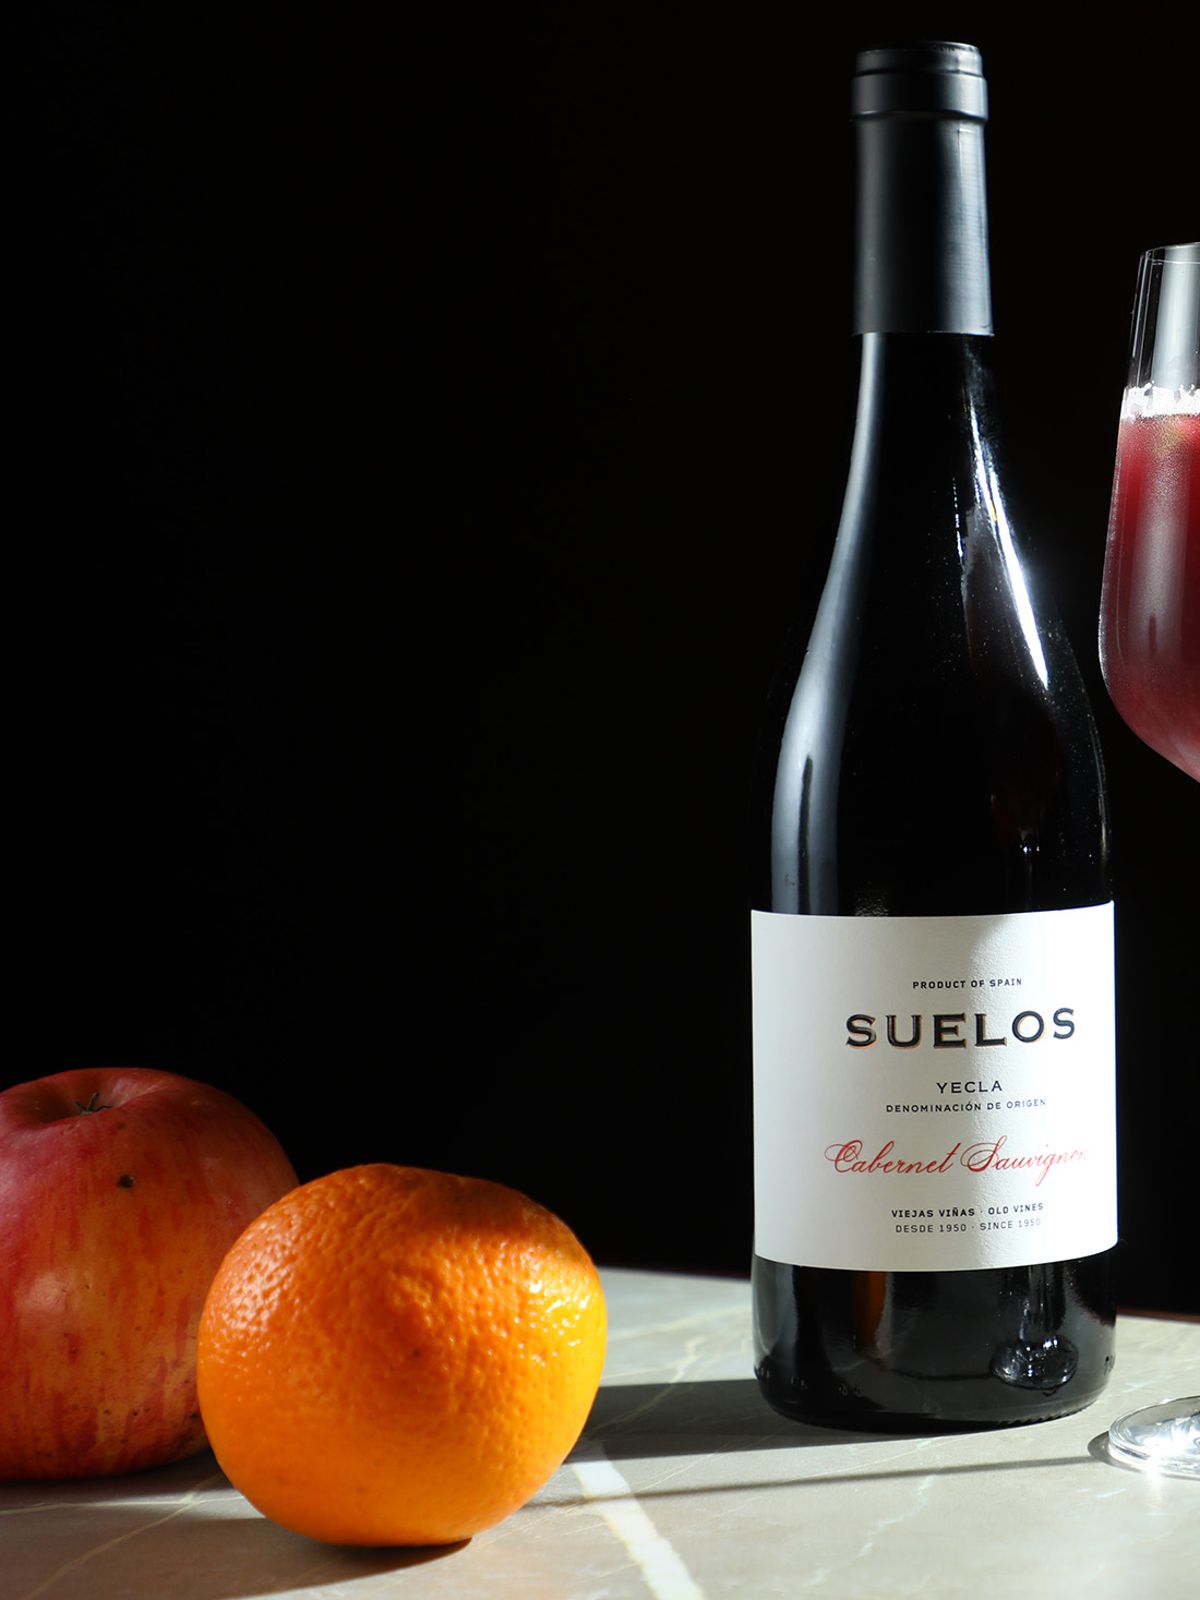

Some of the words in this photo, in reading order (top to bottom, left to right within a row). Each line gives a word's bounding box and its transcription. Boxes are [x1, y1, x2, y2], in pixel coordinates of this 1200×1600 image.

[912, 980, 966, 989] PRODUCT
[971, 979, 985, 988] OF
[989, 977, 1022, 987] SPAIN
[845, 1007, 1076, 1049] SUELOS
[936, 1080, 1003, 1094] YECLA
[886, 1100, 982, 1113] DENOMINACIÓN
[987, 1102, 1001, 1110] DE
[1006, 1098, 1046, 1109] ORIGEN
[823, 1139, 962, 1174] Cabernet
[891, 1209, 934, 1218] VIEJAS
[938, 1206, 976, 1217] VIÑAS
[988, 1206, 1009, 1215] OLD
[1013, 1202, 1044, 1213] VINES
[895, 1224, 934, 1233] DESDE
[939, 1223, 967, 1233] 1950
[979, 1220, 1013, 1231] SINCE
[1018, 1217, 1042, 1228] 1950
